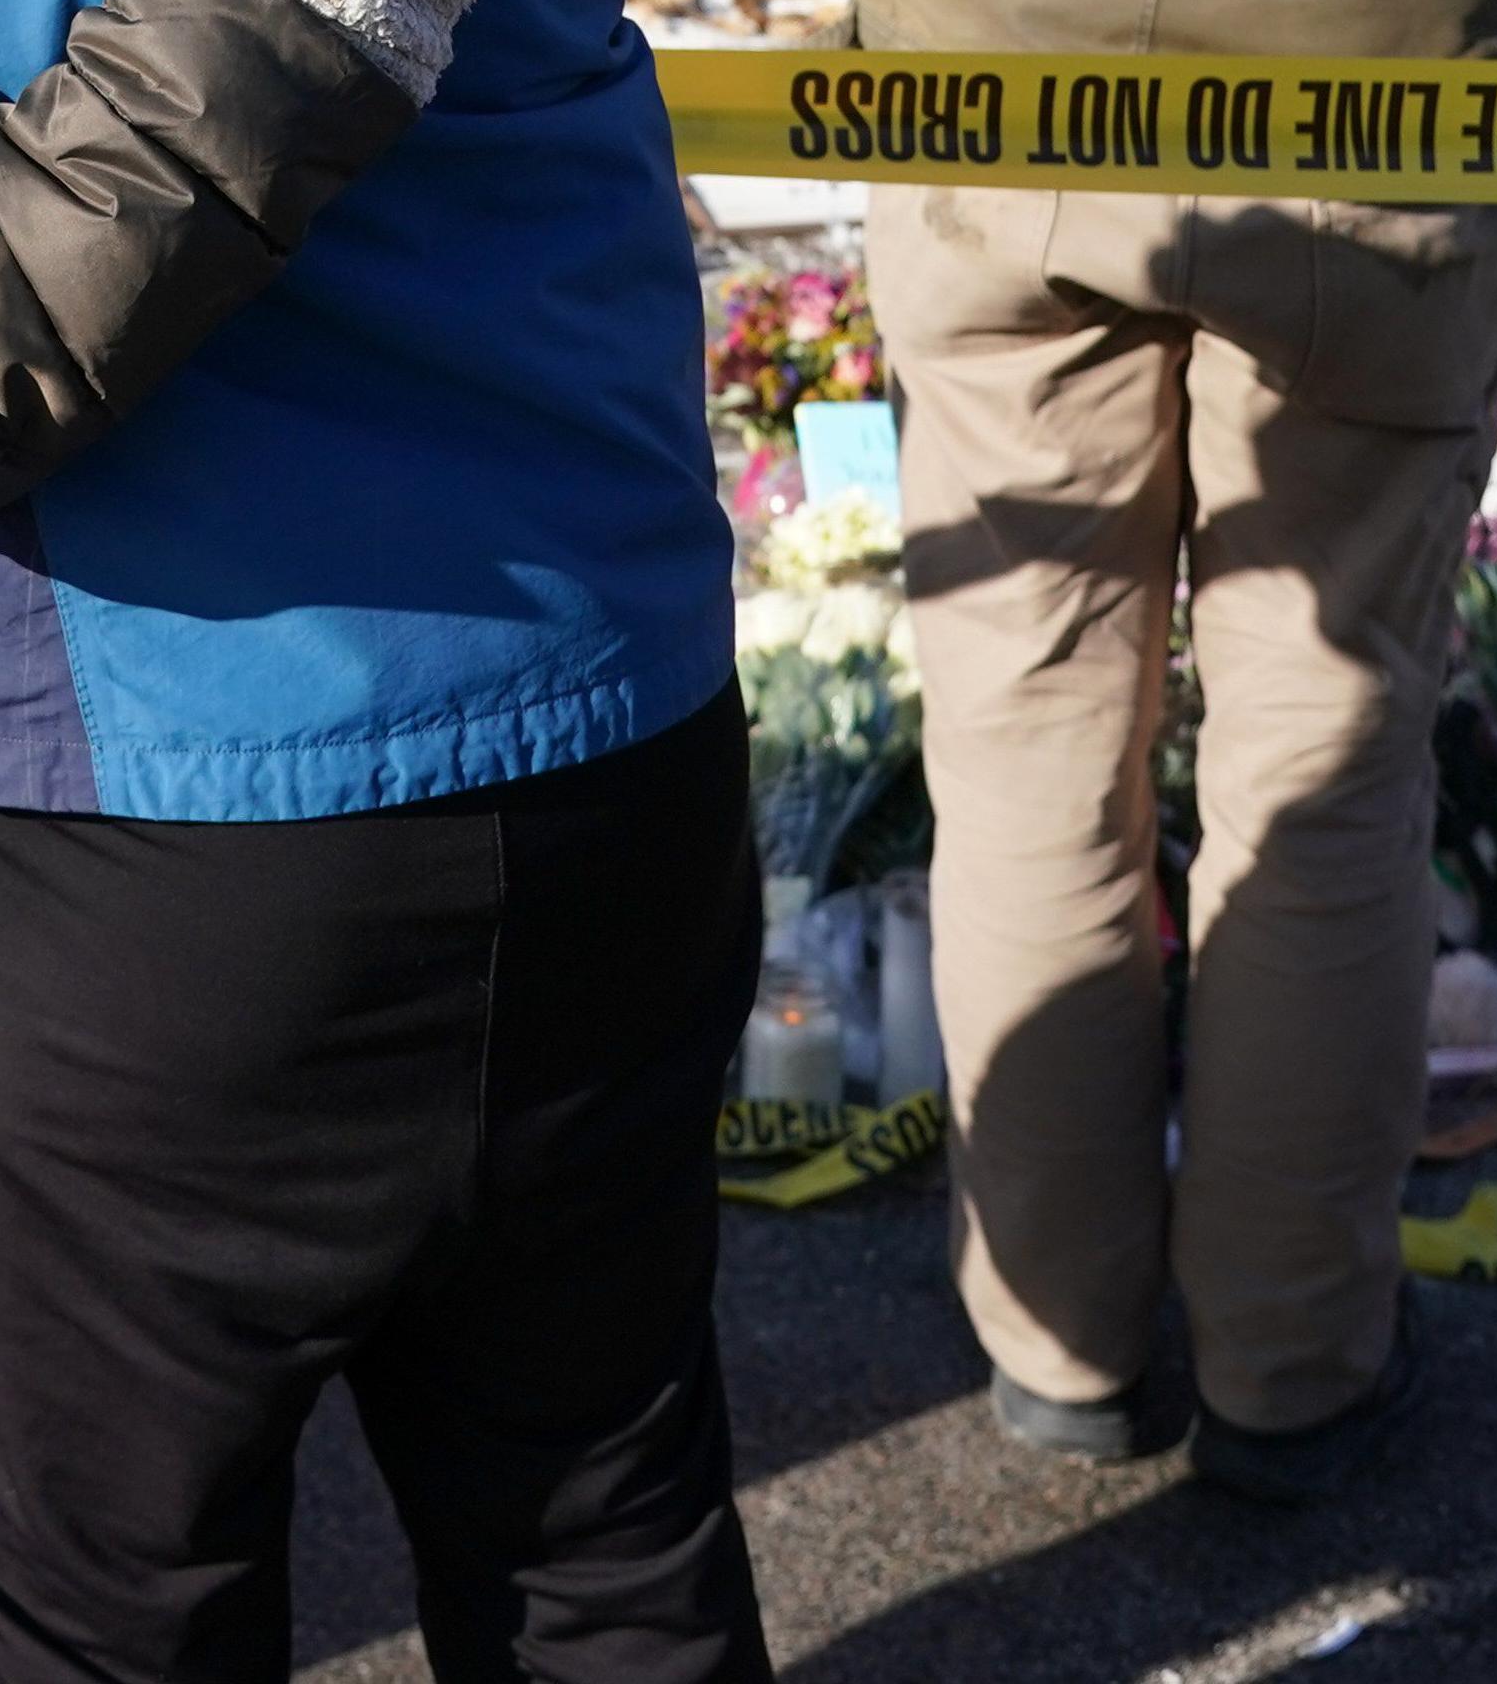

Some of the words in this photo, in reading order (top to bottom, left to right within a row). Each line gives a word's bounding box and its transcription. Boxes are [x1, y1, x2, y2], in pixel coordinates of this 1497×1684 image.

[789, 68, 1006, 164] CROSS
[1028, 73, 1160, 168] NOT
[1186, 74, 1270, 170] DO
[1295, 77, 1436, 172] LINE
